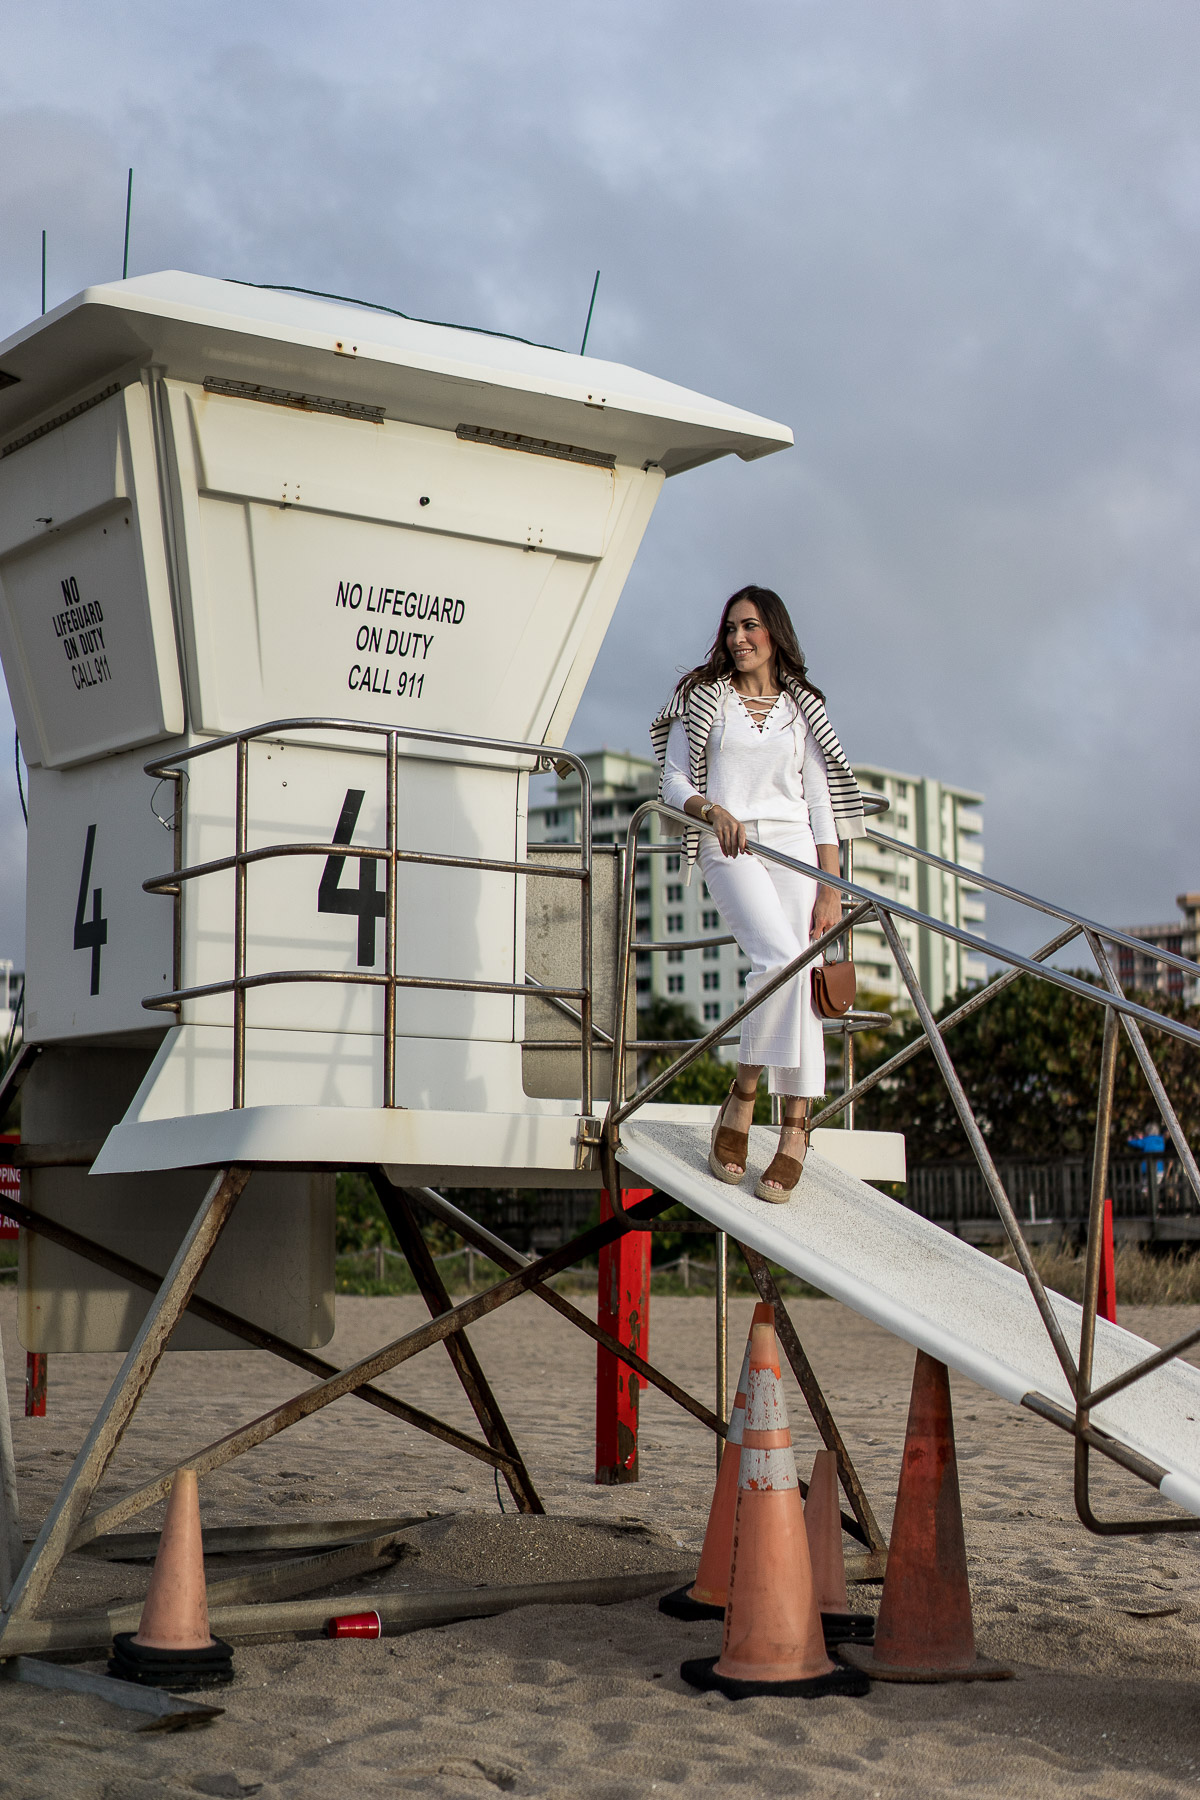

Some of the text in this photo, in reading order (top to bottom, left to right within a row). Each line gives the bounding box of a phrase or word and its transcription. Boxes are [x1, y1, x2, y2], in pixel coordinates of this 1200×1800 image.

[61, 576, 80, 607] NO
[335, 580, 466, 625] NO LIFEGUARD
[52, 600, 104, 637] LIFEGUARD
[63, 627, 106, 661] ON DUTY
[355, 625, 434, 660] ON DUTY
[71, 655, 112, 690] CALL 911
[348, 664, 425, 698] CALL 911
[318, 788, 387, 967] 4
[73, 824, 108, 996] 4
